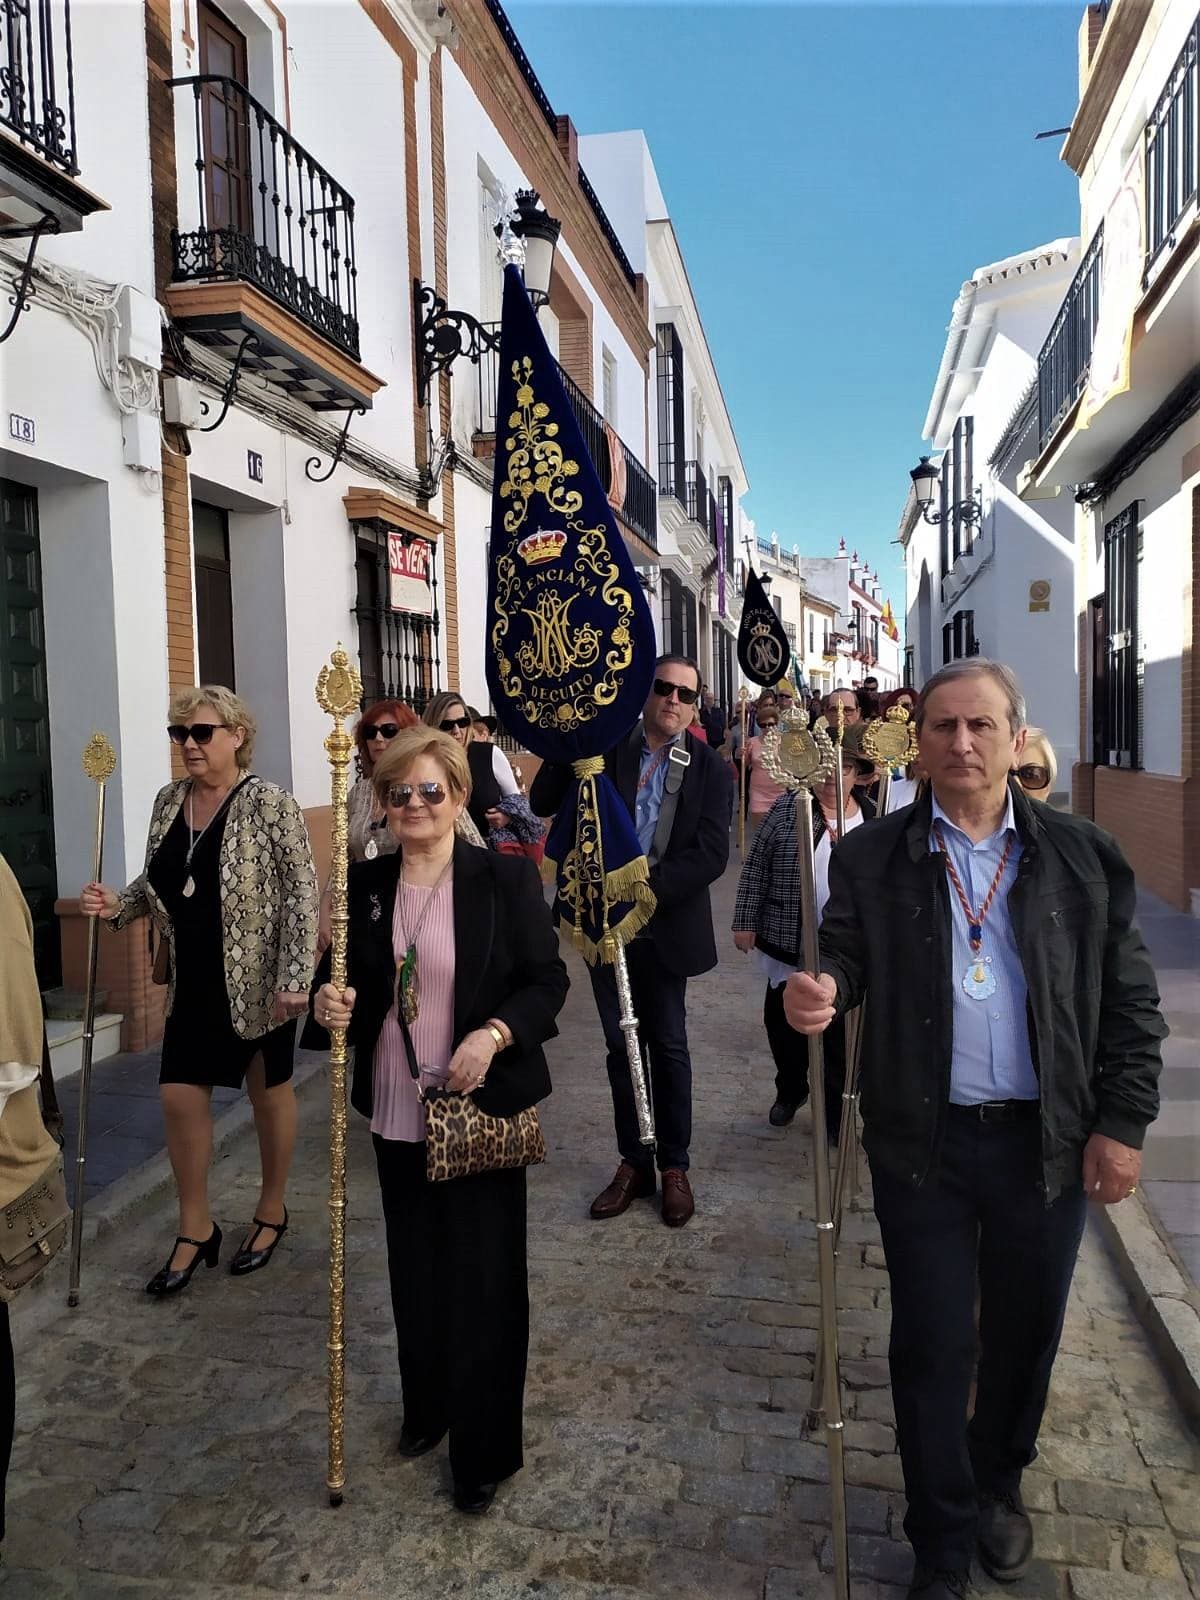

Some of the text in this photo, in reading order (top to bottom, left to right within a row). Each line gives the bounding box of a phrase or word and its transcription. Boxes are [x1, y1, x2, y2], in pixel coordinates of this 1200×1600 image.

[16, 418, 31, 438] 18
[250, 453, 263, 480] 16
[389, 538, 404, 570] SE
